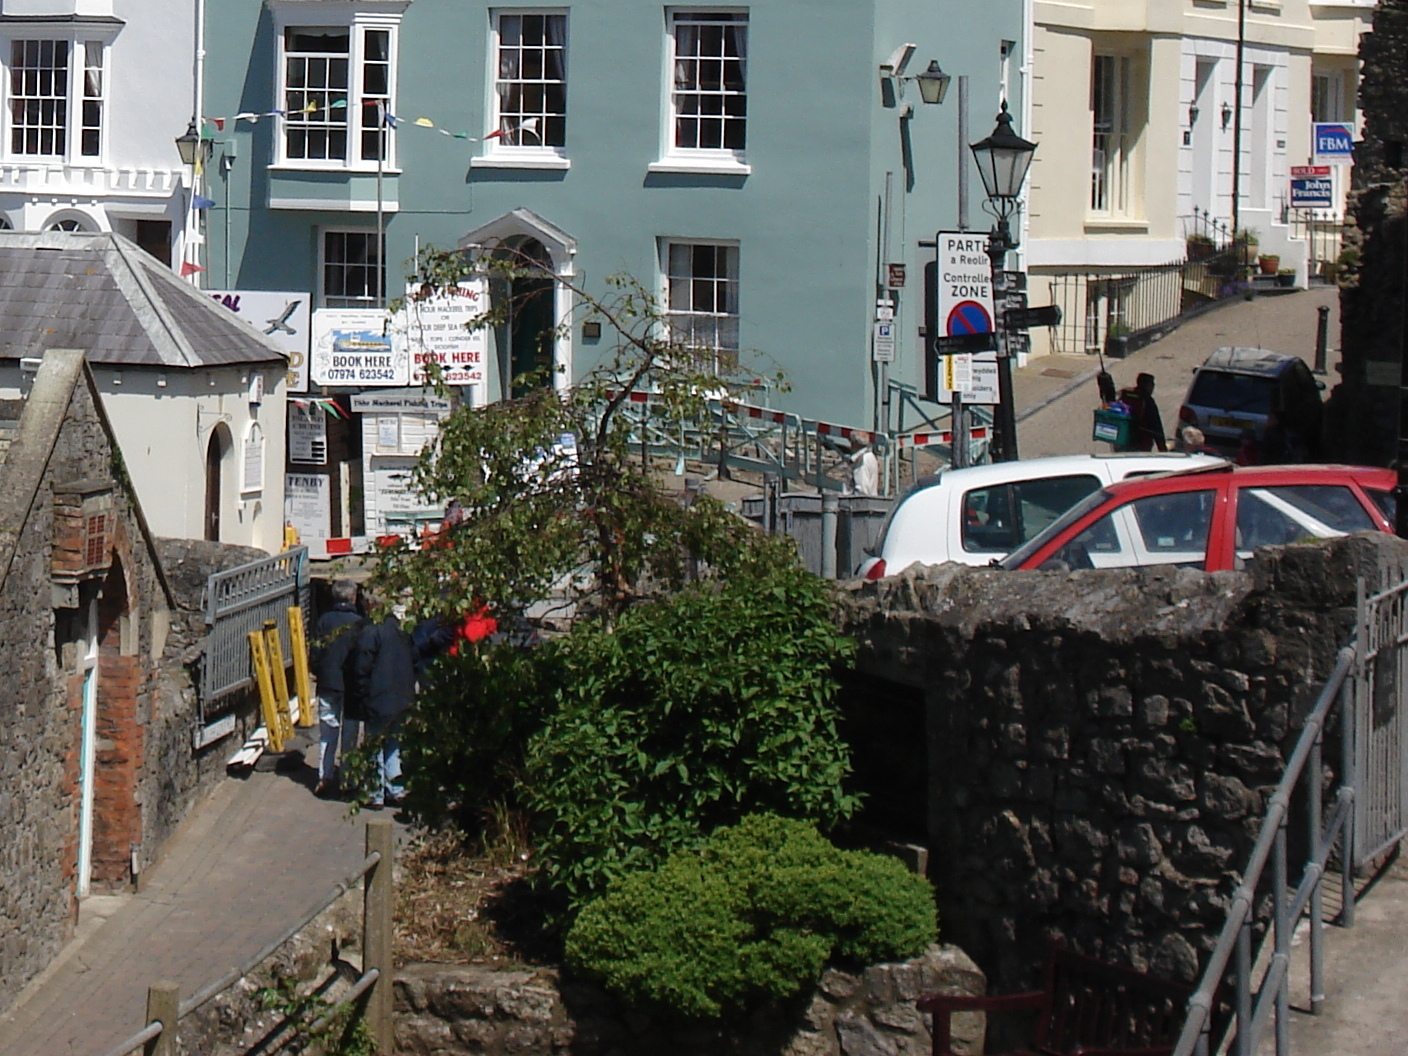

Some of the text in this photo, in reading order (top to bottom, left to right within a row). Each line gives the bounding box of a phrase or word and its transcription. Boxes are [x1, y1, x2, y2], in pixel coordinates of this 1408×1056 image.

[1319, 137, 1349, 151] FBM
[1305, 179, 1331, 190] John
[1293, 189, 1331, 198] Francis
[951, 286, 988, 298] ZONE
[333, 355, 392, 367] BOOK HERE
[414, 352, 481, 365] BOOK HERE
[328, 369, 395, 380] 07974 623542
[288, 476, 324, 488] TENBY
